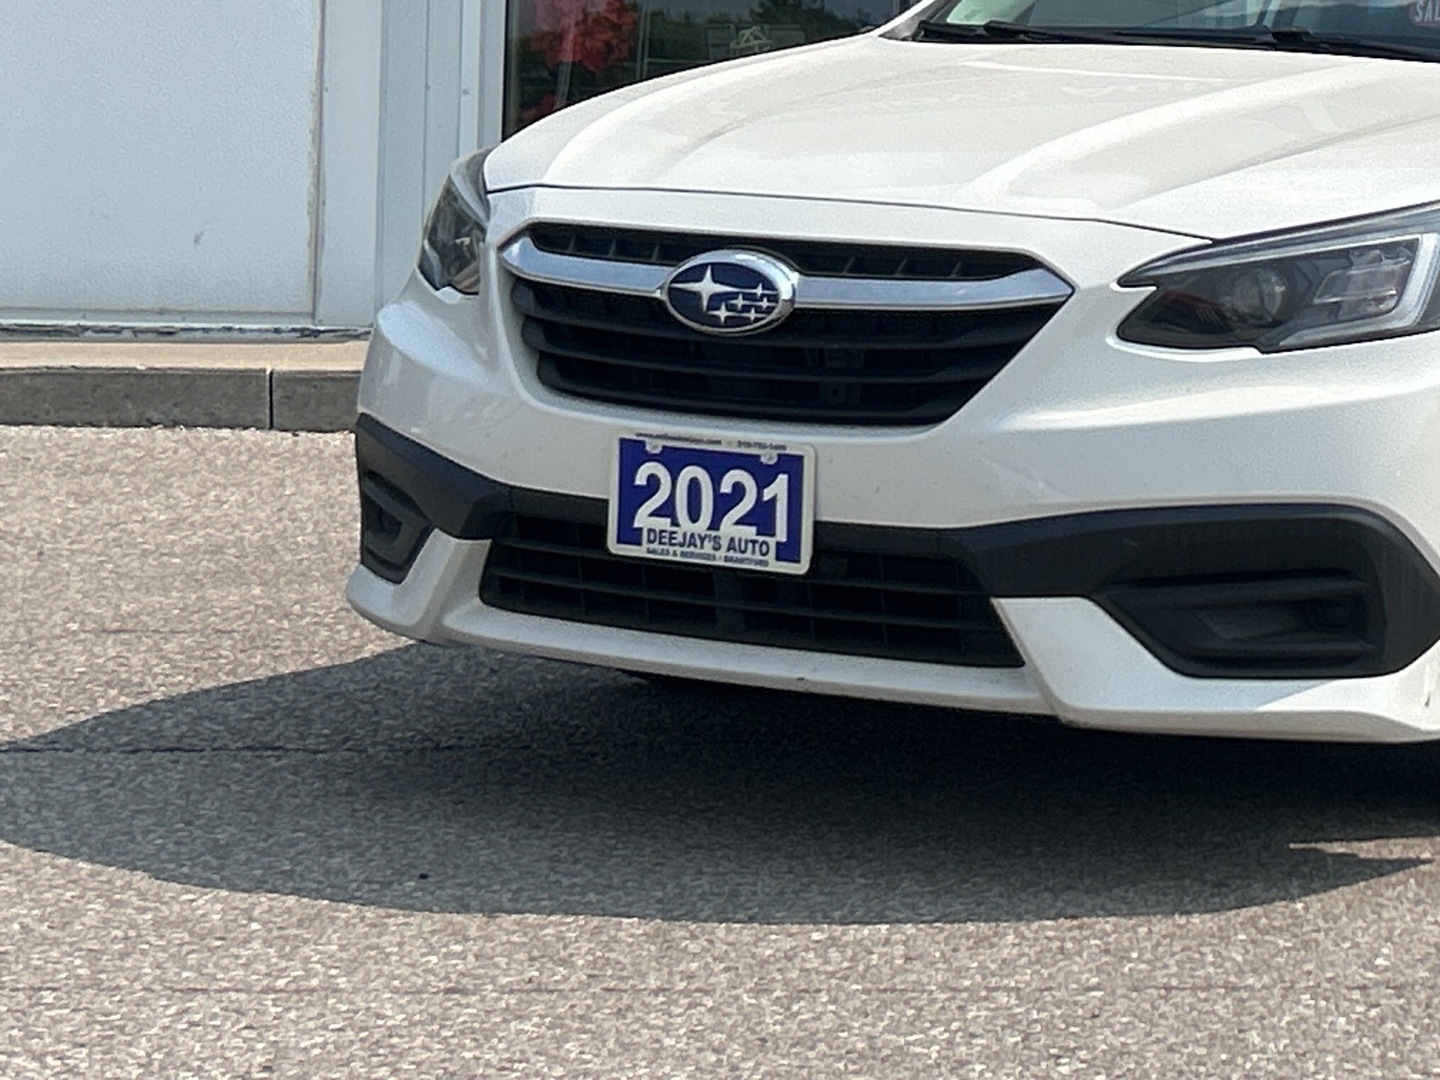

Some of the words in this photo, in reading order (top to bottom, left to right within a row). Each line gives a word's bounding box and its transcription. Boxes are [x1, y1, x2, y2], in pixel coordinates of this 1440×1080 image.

[633, 461, 789, 543] 2021
[646, 528, 722, 552] DEEJAY'S
[726, 536, 771, 557] AUTO
